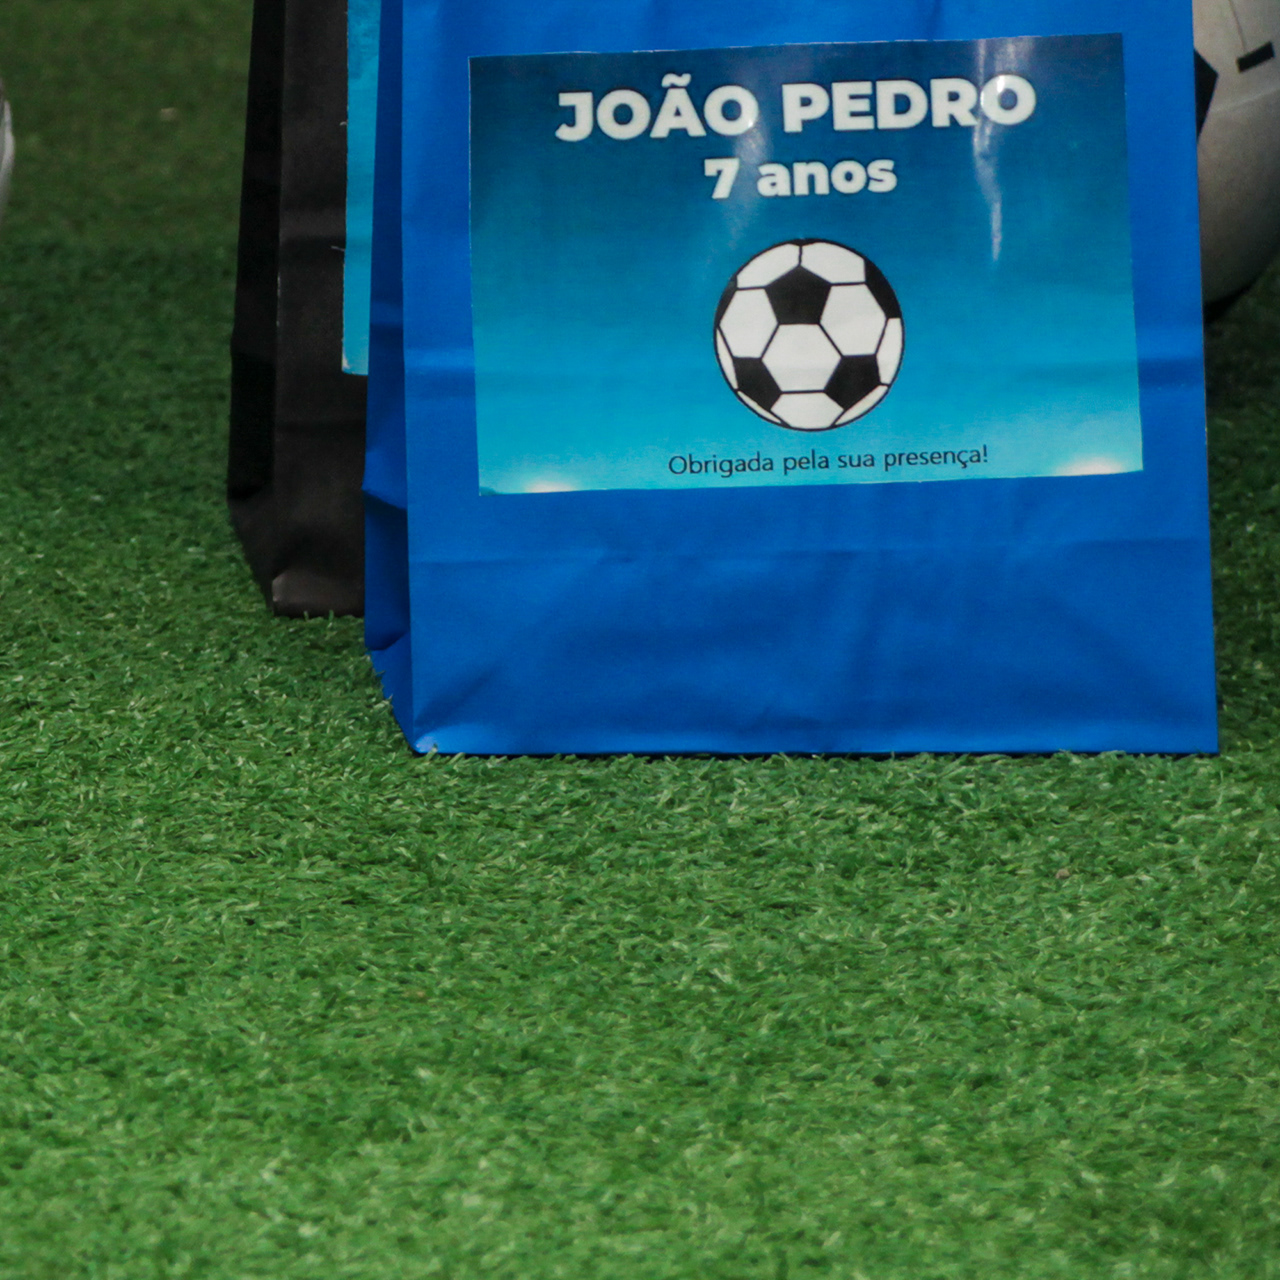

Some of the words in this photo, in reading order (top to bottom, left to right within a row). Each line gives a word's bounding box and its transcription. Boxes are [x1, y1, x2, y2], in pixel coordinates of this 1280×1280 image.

[555, 73, 759, 141] JOÃO
[782, 74, 1037, 133] PEDRO
[704, 157, 740, 198] 7
[757, 158, 898, 197] anos
[668, 451, 774, 478] Obrigada
[783, 449, 829, 475] pela
[837, 451, 875, 468] sua
[884, 444, 988, 472] presença!
